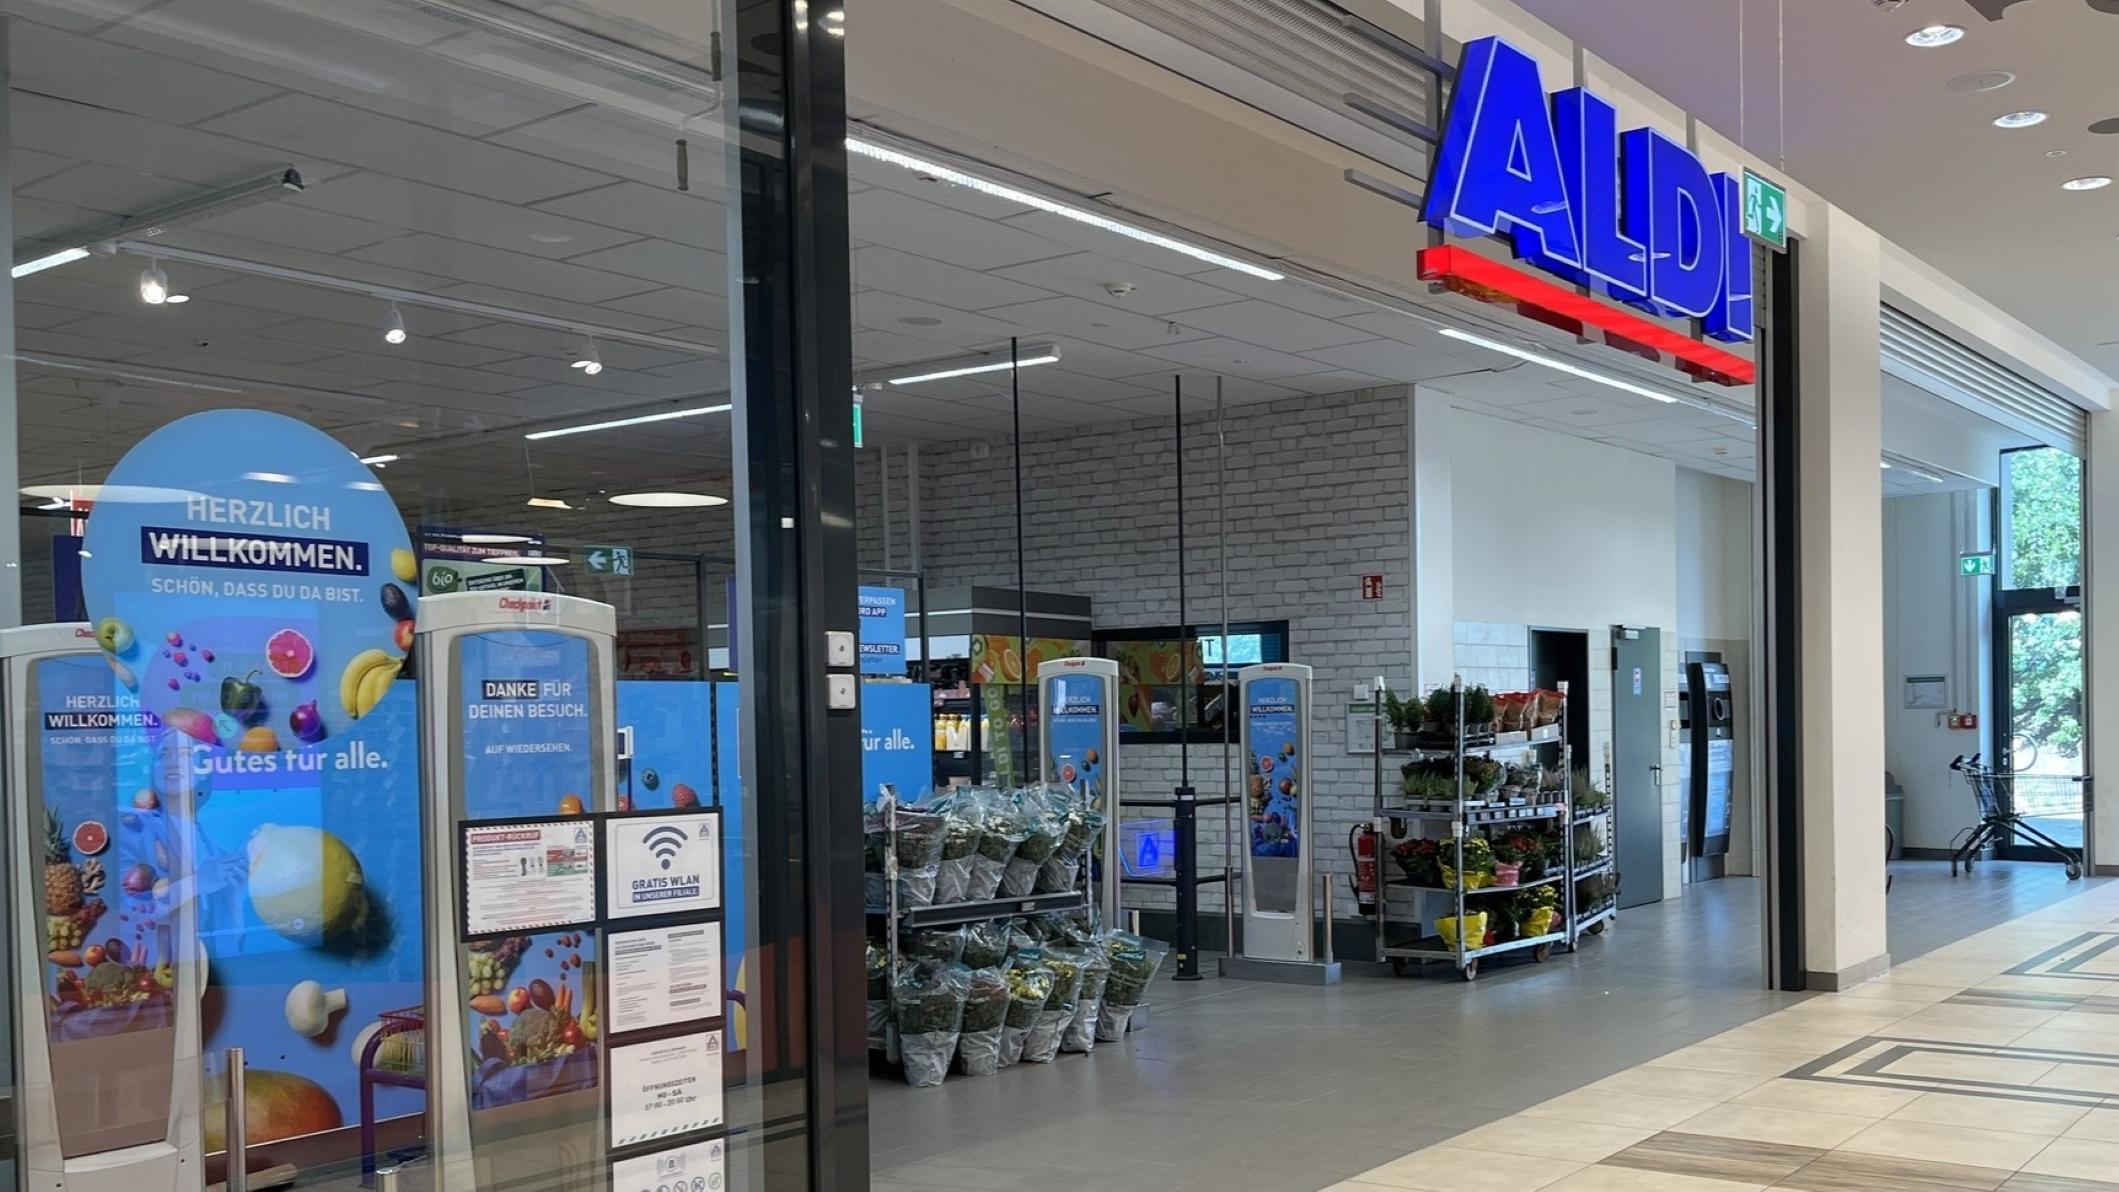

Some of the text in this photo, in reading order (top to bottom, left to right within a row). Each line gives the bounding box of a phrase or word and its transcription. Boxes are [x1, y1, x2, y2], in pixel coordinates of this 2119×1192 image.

[1419, 35, 1753, 343] ALDI
[186, 494, 331, 531] HERZLICH
[148, 532, 363, 571] WILLKOMMEN.
[432, 571, 453, 587] bio
[151, 576, 364, 602] SCHÖN, DASS DU DA BIST.
[858, 597, 896, 606] ERPASSEN
[873, 608, 886, 616] APP
[486, 680, 572, 697] DANKE FÜR
[66, 695, 140, 709] HERZLICH
[468, 703, 588, 719] DEINEN BESUCH.
[48, 714, 158, 728] WILLKOMMEN.
[884, 728, 915, 750] alle.
[485, 743, 572, 754] AUF WIEDERSEHEN.
[192, 745, 277, 775] Gutes
[334, 740, 388, 769] alle.
[632, 874, 699, 890] GRATIS WLAN
